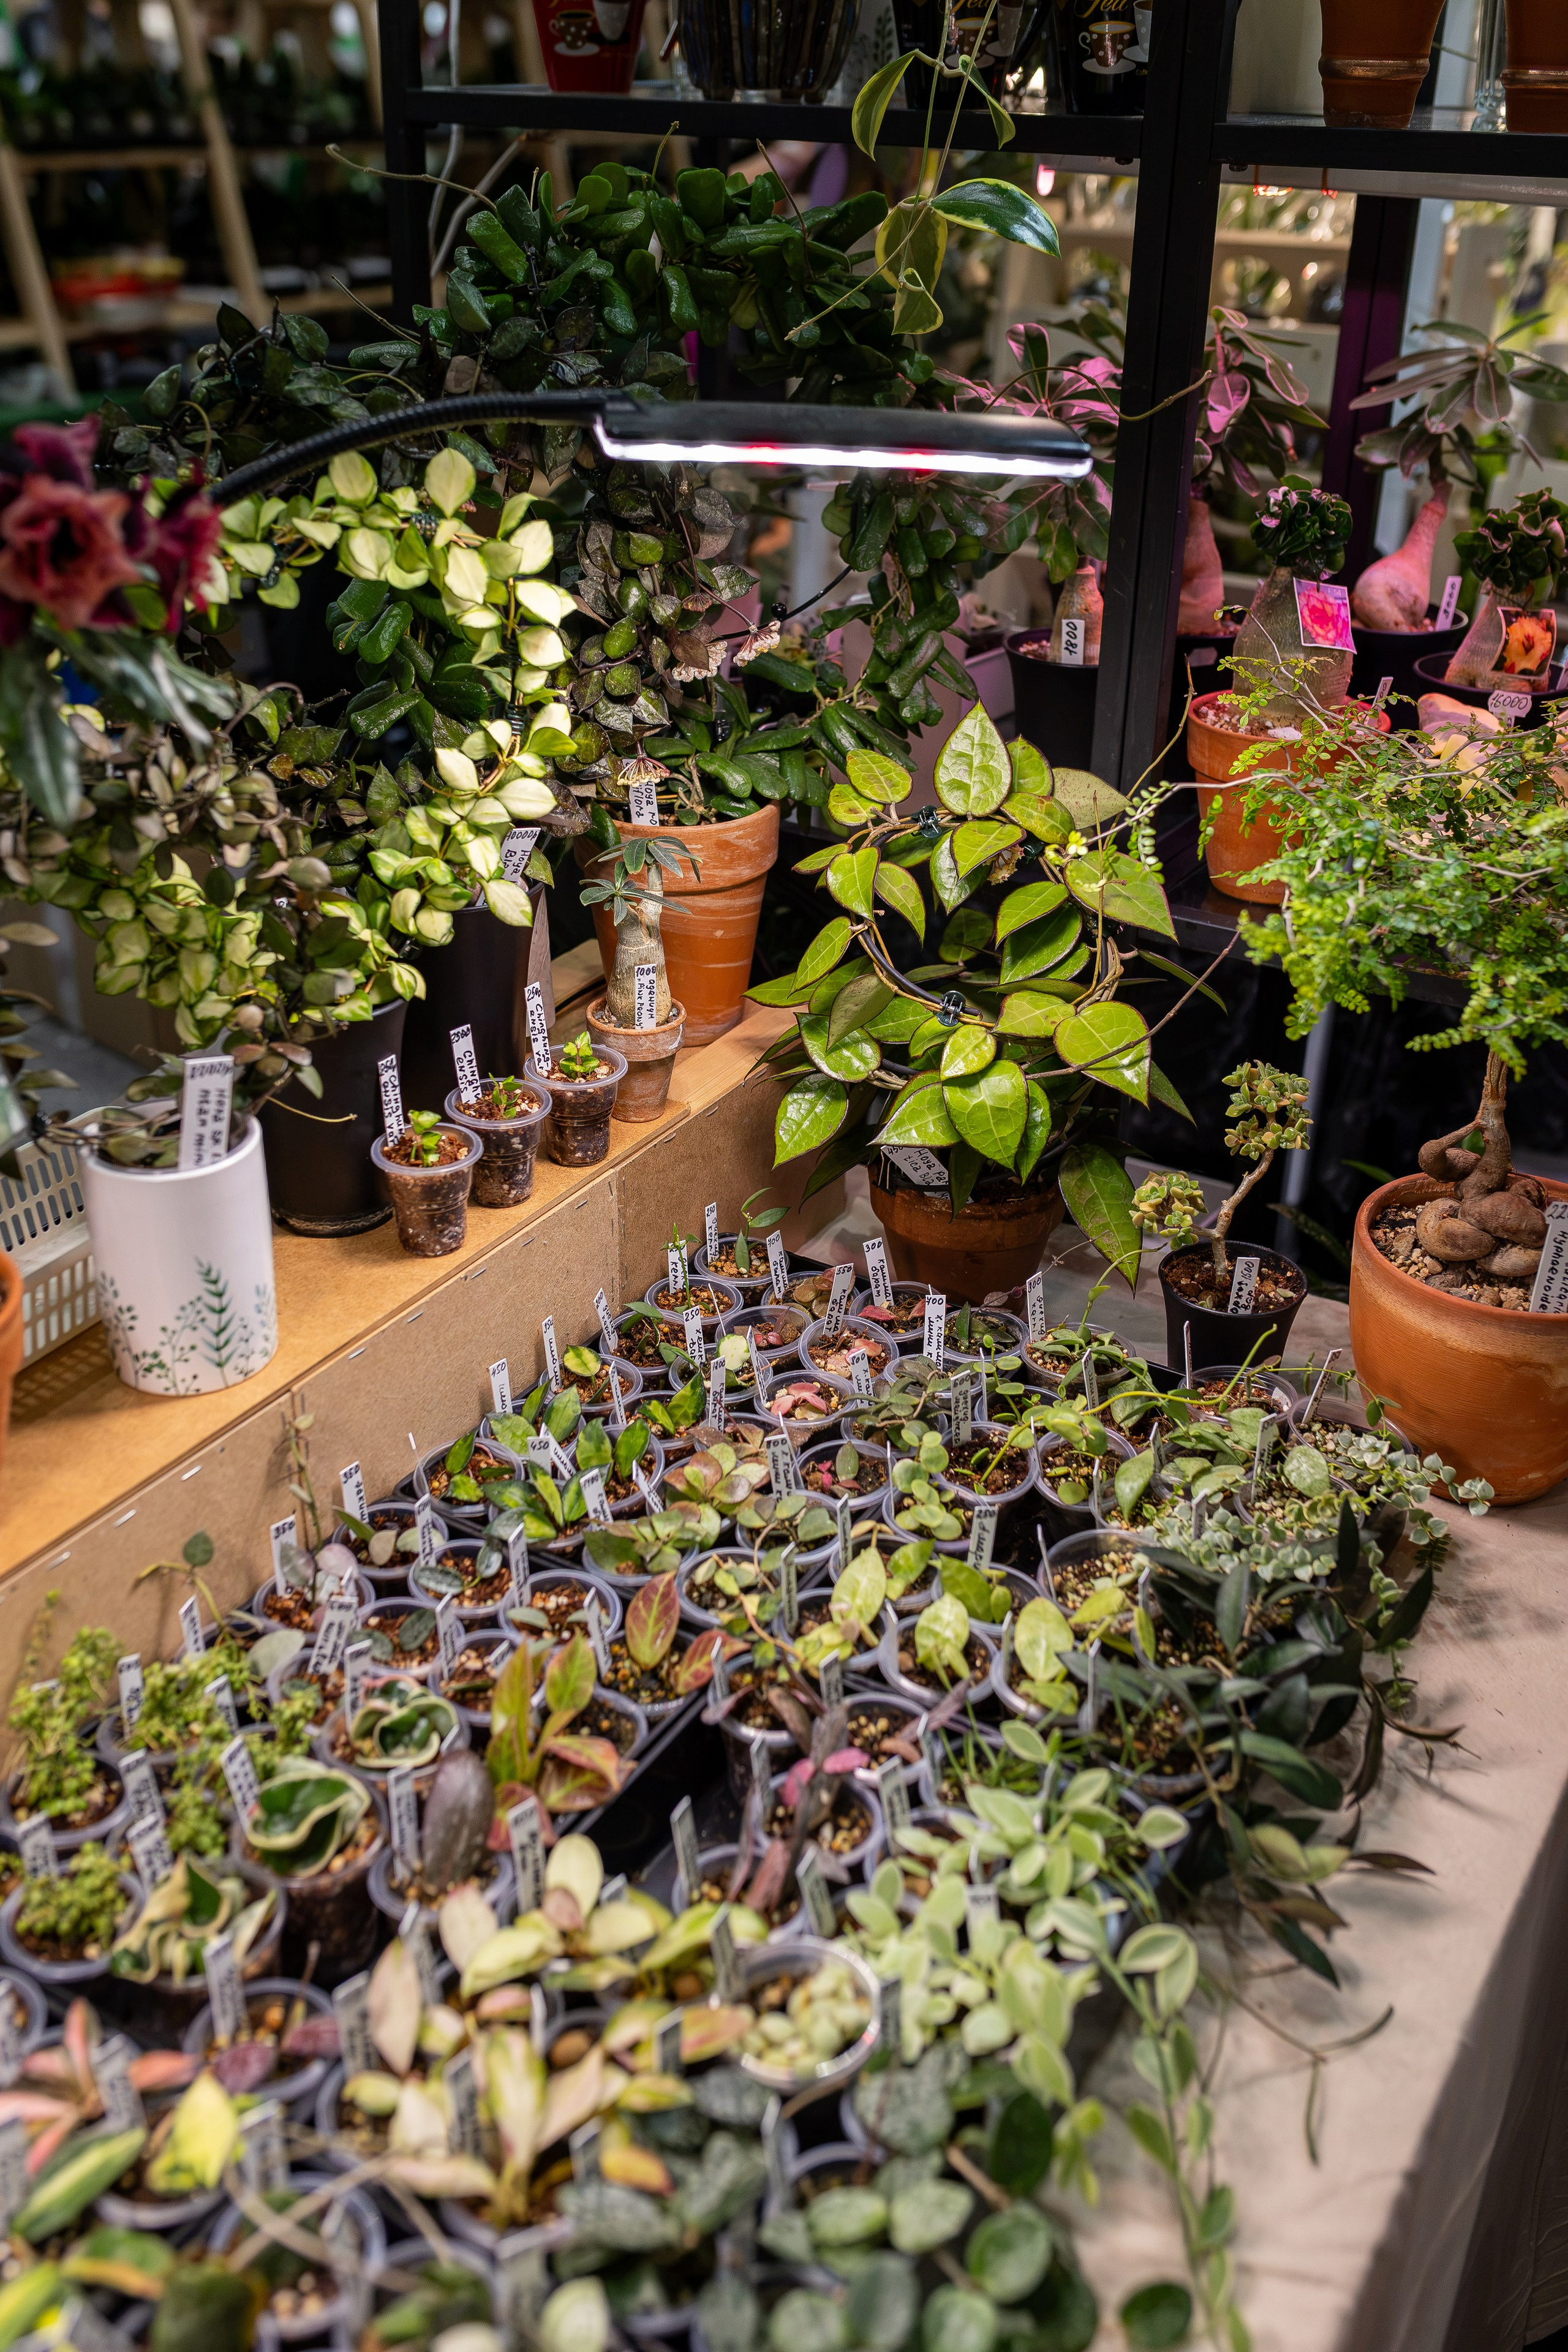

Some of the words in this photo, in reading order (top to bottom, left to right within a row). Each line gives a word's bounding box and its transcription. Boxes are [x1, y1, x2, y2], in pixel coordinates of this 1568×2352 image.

[1064, 621, 1077, 655] 1800
[1490, 692, 1529, 710] 16000
[914, 1148, 936, 1170] Hoya
[865, 1240, 882, 1253] 300
[836, 1265, 852, 1275] 550
[1241, 1261, 1254, 1280] 1500
[1537, 1231, 1568, 1313] Hyphaenoide
[1028, 1277, 1041, 1294] 300
[685, 1308, 699, 1322] 250
[492, 1362, 506, 1378] 450
[530, 1441, 549, 1451] 450
